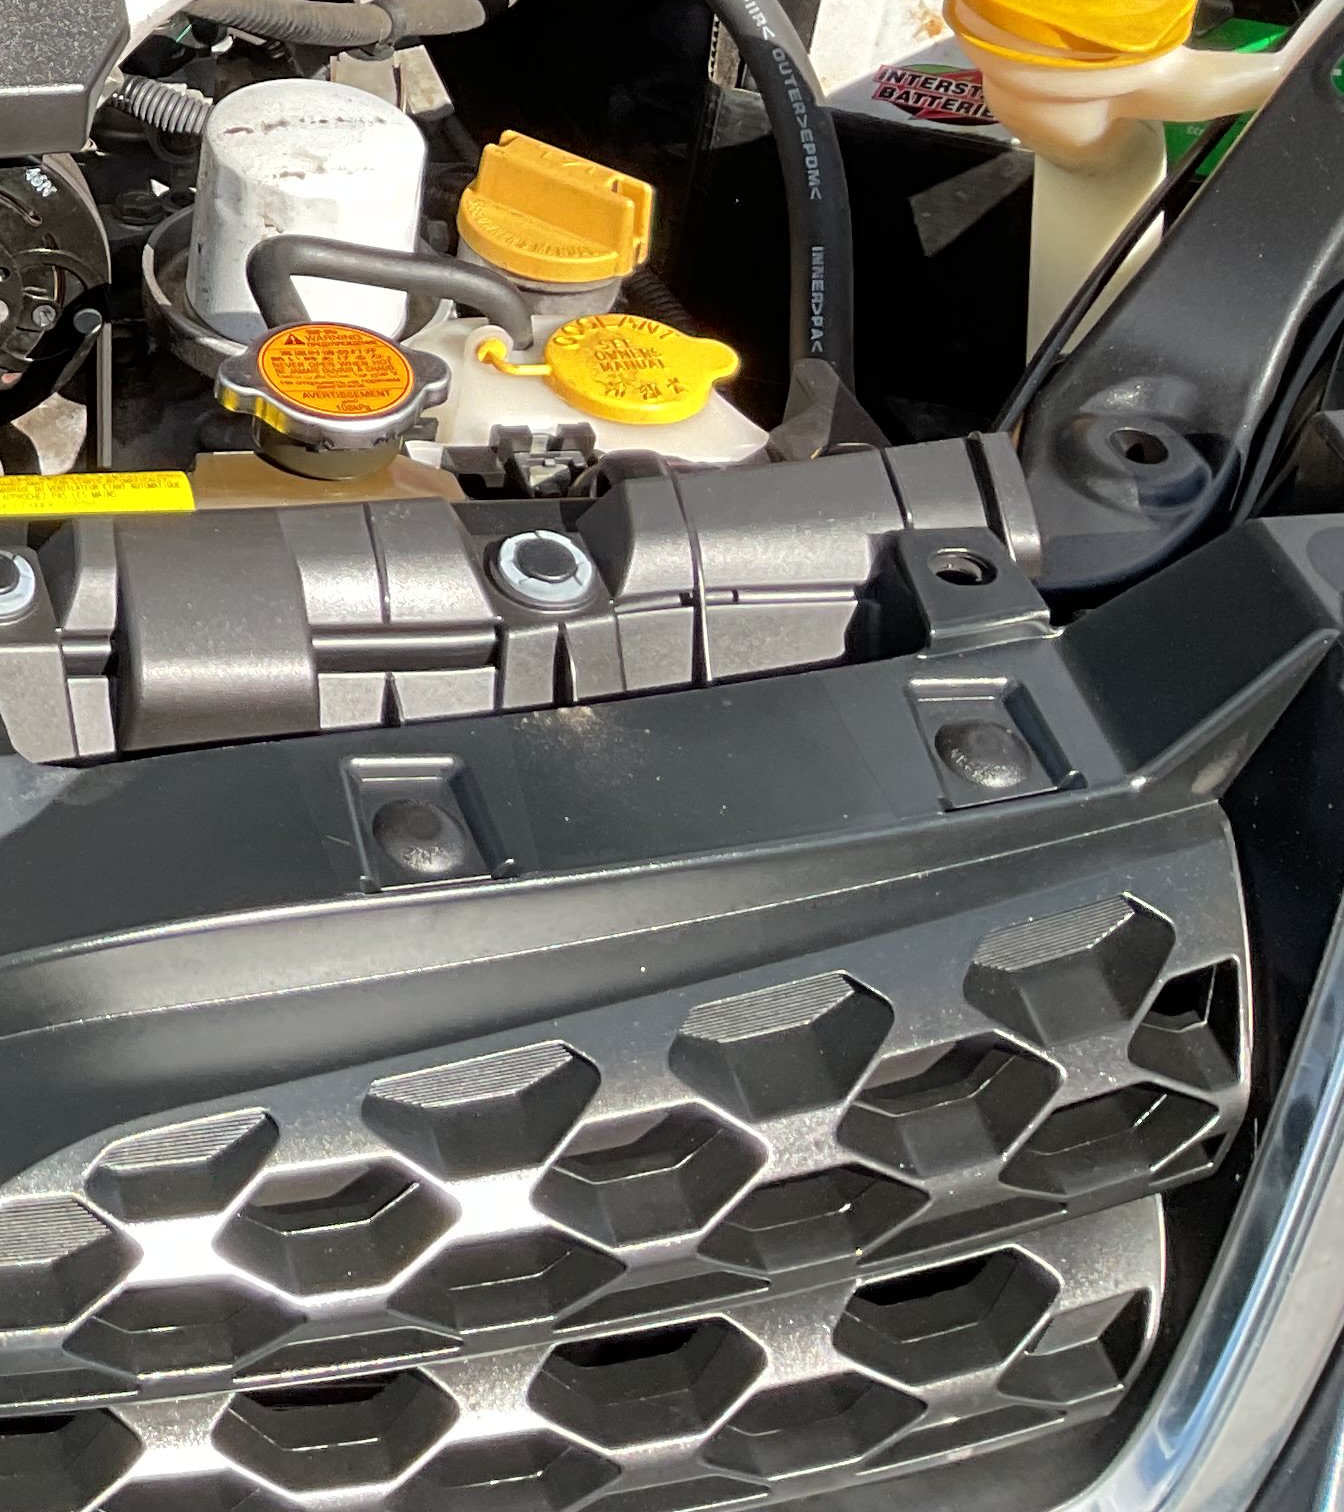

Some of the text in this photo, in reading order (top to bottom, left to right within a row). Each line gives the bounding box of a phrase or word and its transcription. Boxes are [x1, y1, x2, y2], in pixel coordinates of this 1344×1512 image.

[878, 68, 984, 99] INTERST
[305, 333, 362, 342] WARNING
[597, 338, 632, 350] SEE
[598, 359, 665, 373] MANUAL
[302, 389, 391, 399] AVERTISSEMENT
